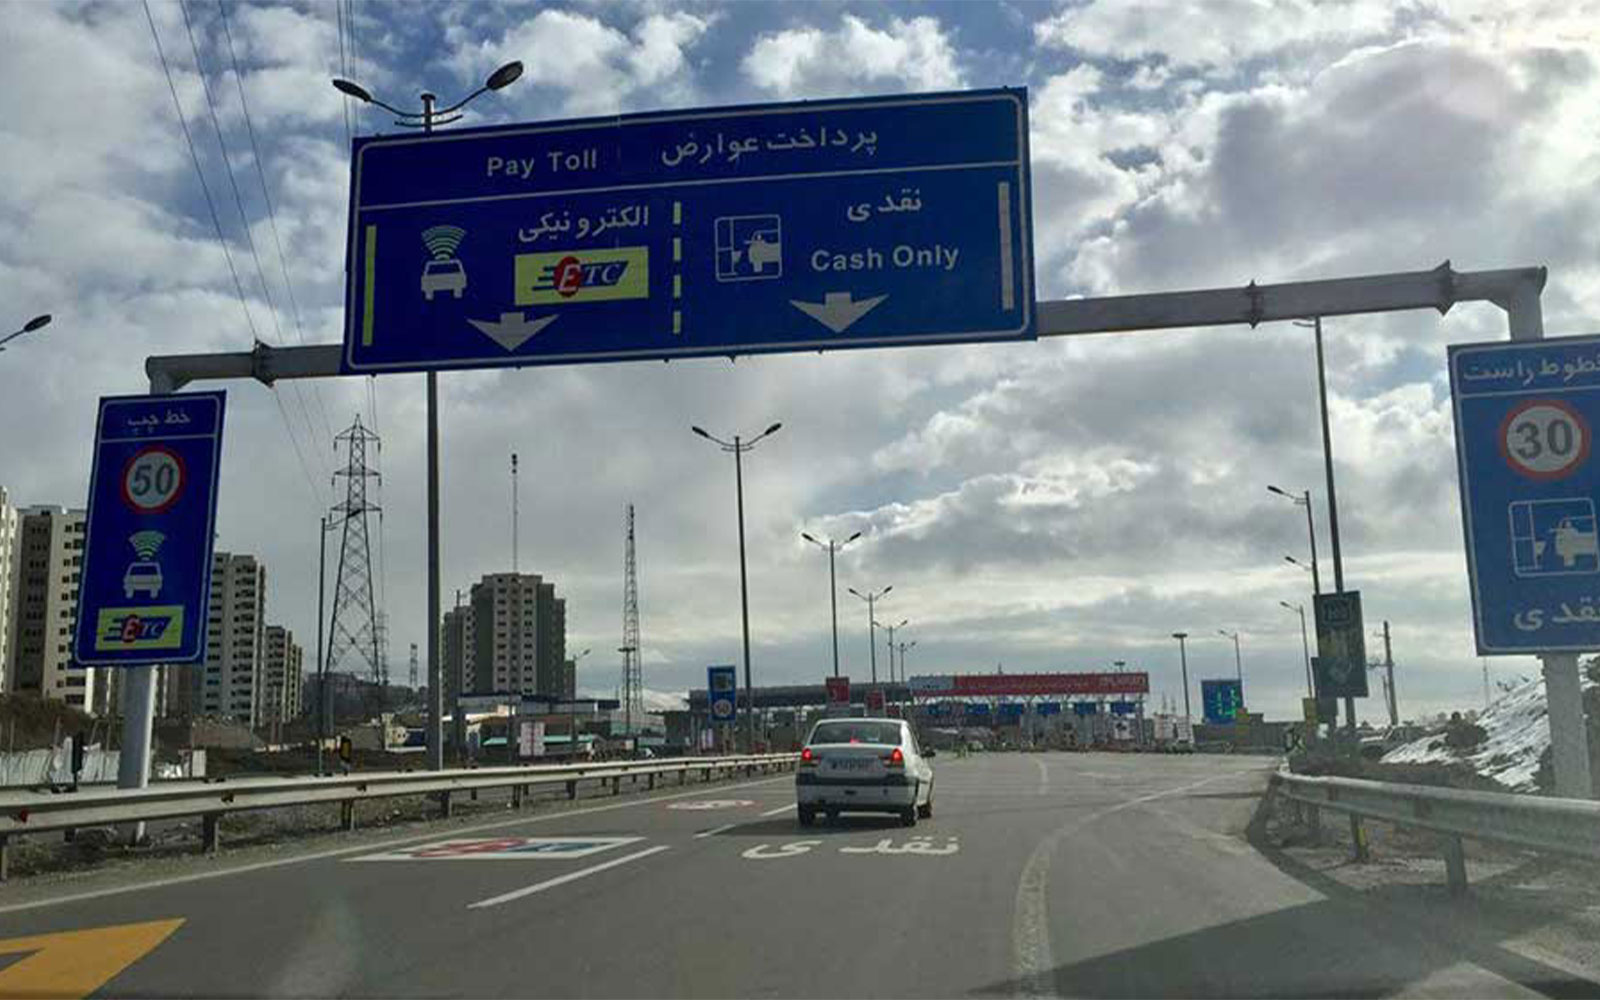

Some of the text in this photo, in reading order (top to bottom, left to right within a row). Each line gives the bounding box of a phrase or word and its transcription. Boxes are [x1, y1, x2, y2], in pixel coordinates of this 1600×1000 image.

[662, 127, 878, 166] پرداخت عوارض
[487, 149, 597, 179] Pay Toll
[847, 187, 922, 222] نقدی
[518, 205, 649, 242] الکترونیکی
[811, 245, 959, 271] Cash Only
[554, 262, 622, 292] ETC
[1463, 355, 1600, 387] طوط راست
[163, 407, 191, 425] خط
[1515, 418, 1574, 459] 30
[132, 462, 176, 497] 50
[121, 615, 166, 642] ETC
[1513, 596, 1600, 632] قدی
[742, 836, 959, 859] نقدی
